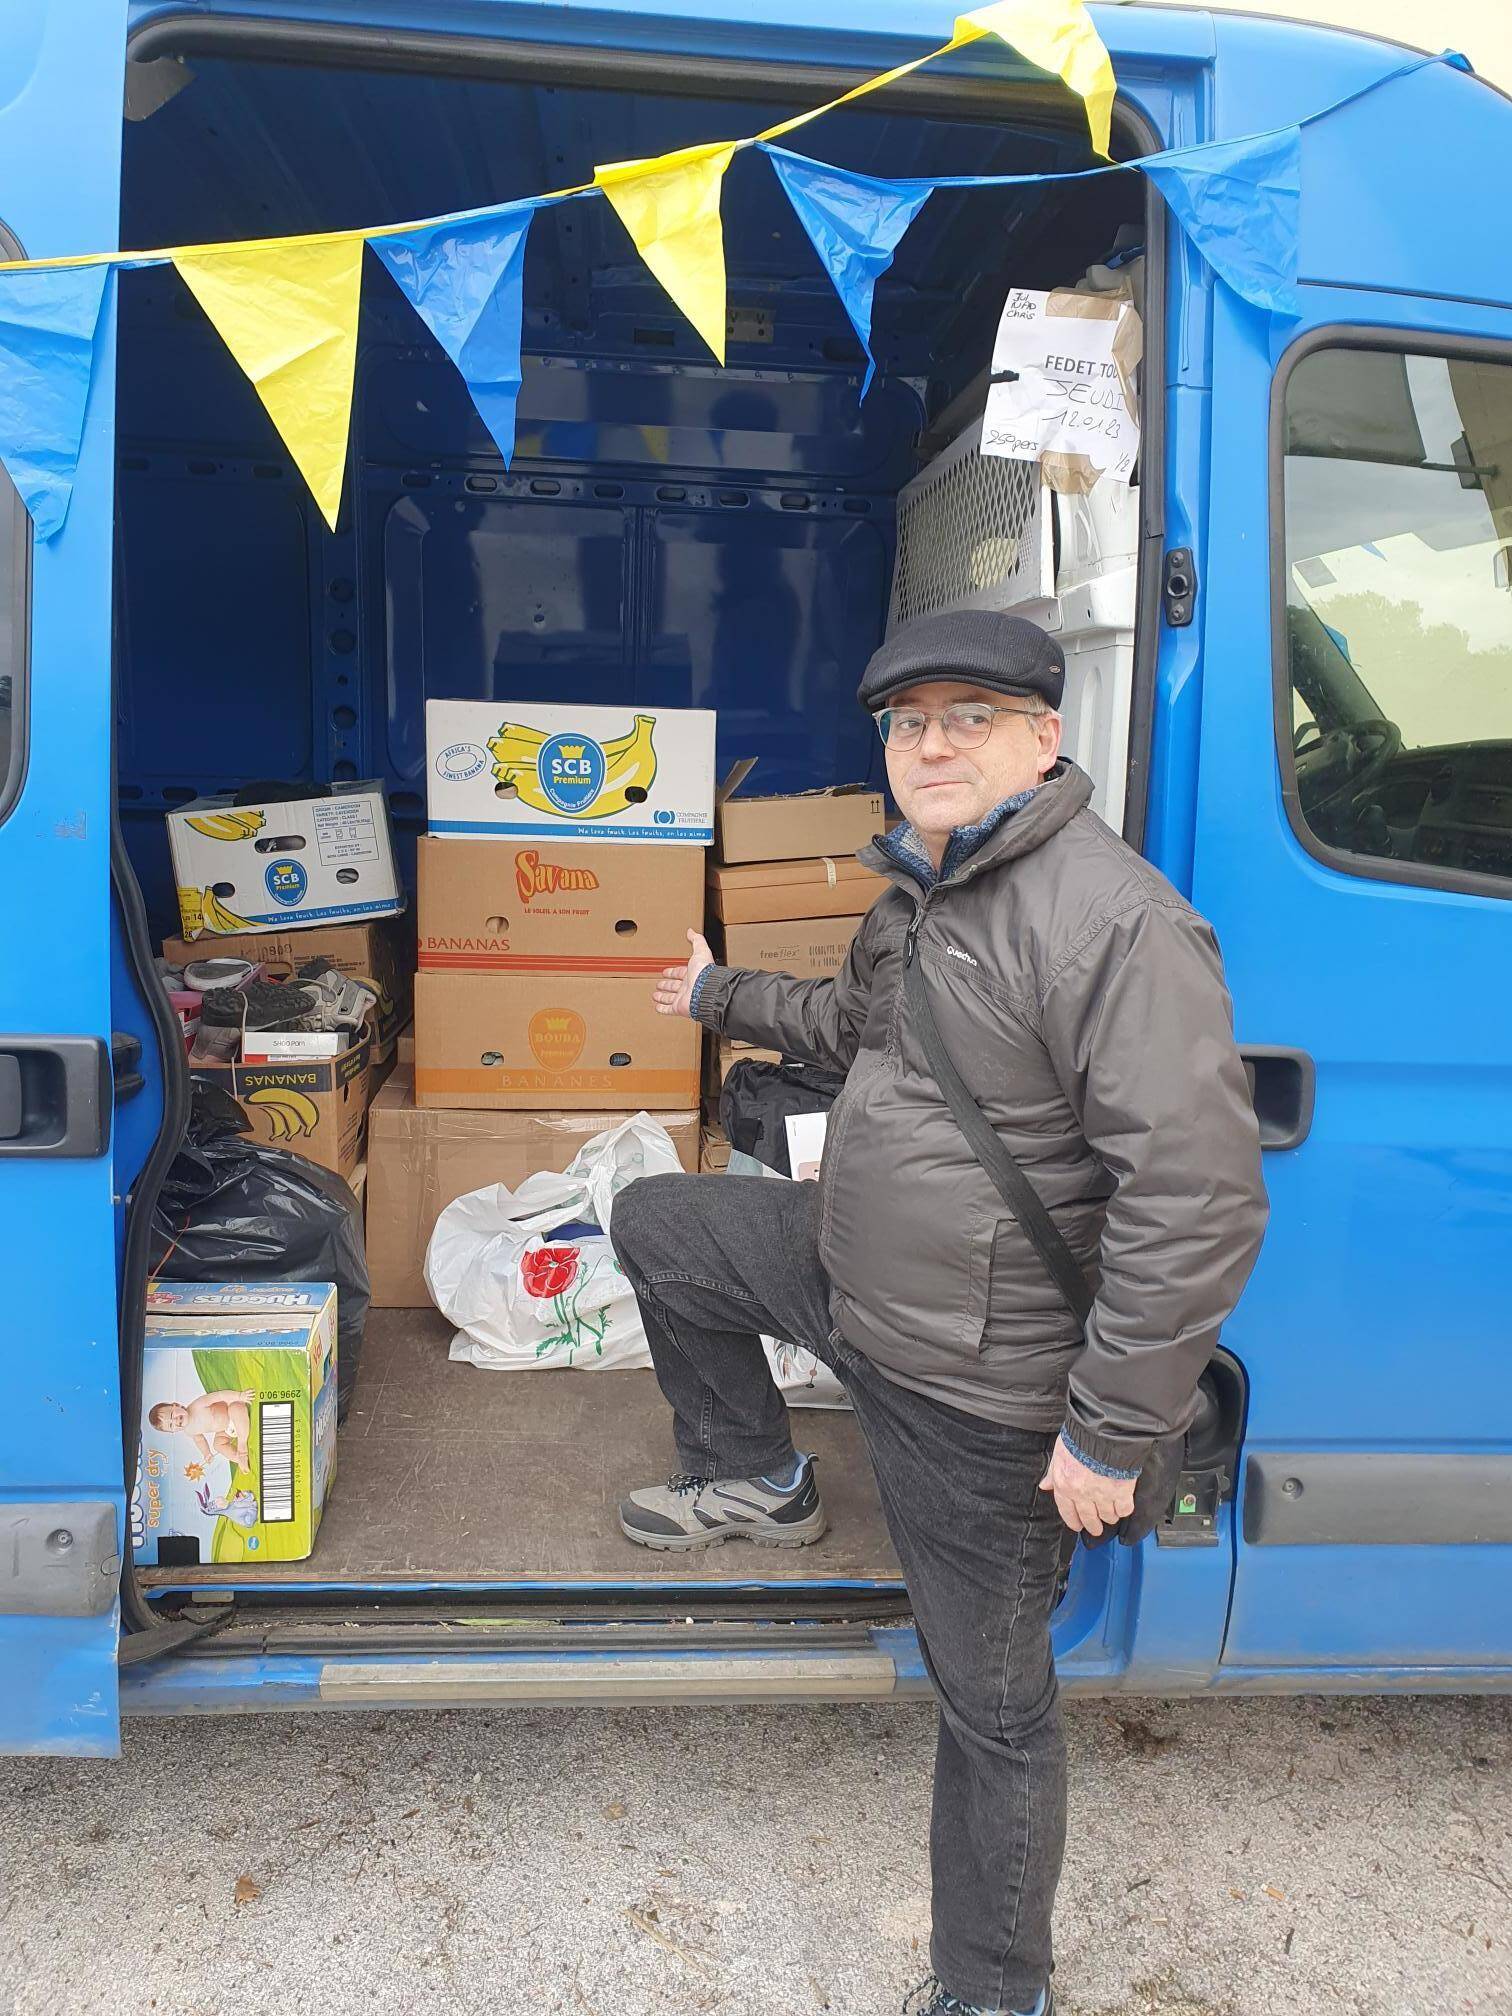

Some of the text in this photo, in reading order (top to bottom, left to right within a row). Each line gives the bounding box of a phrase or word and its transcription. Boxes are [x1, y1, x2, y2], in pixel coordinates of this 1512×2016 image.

[1044, 354, 1097, 376] FEDET
[1042, 377, 1125, 411] JEUDI
[551, 758, 592, 775] SCB
[553, 775, 591, 785] Premium
[273, 873, 300, 886] SCB
[515, 849, 600, 904] Savana
[427, 937, 510, 951] BANANAS
[946, 945, 978, 967] Quechua
[245, 1073, 317, 1086] BANANAS
[502, 1075, 613, 1088] BANANES
[259, 1389, 302, 1400] 2996.90.0
[145, 1448, 168, 1478] dry
[146, 1480, 164, 1529] super
